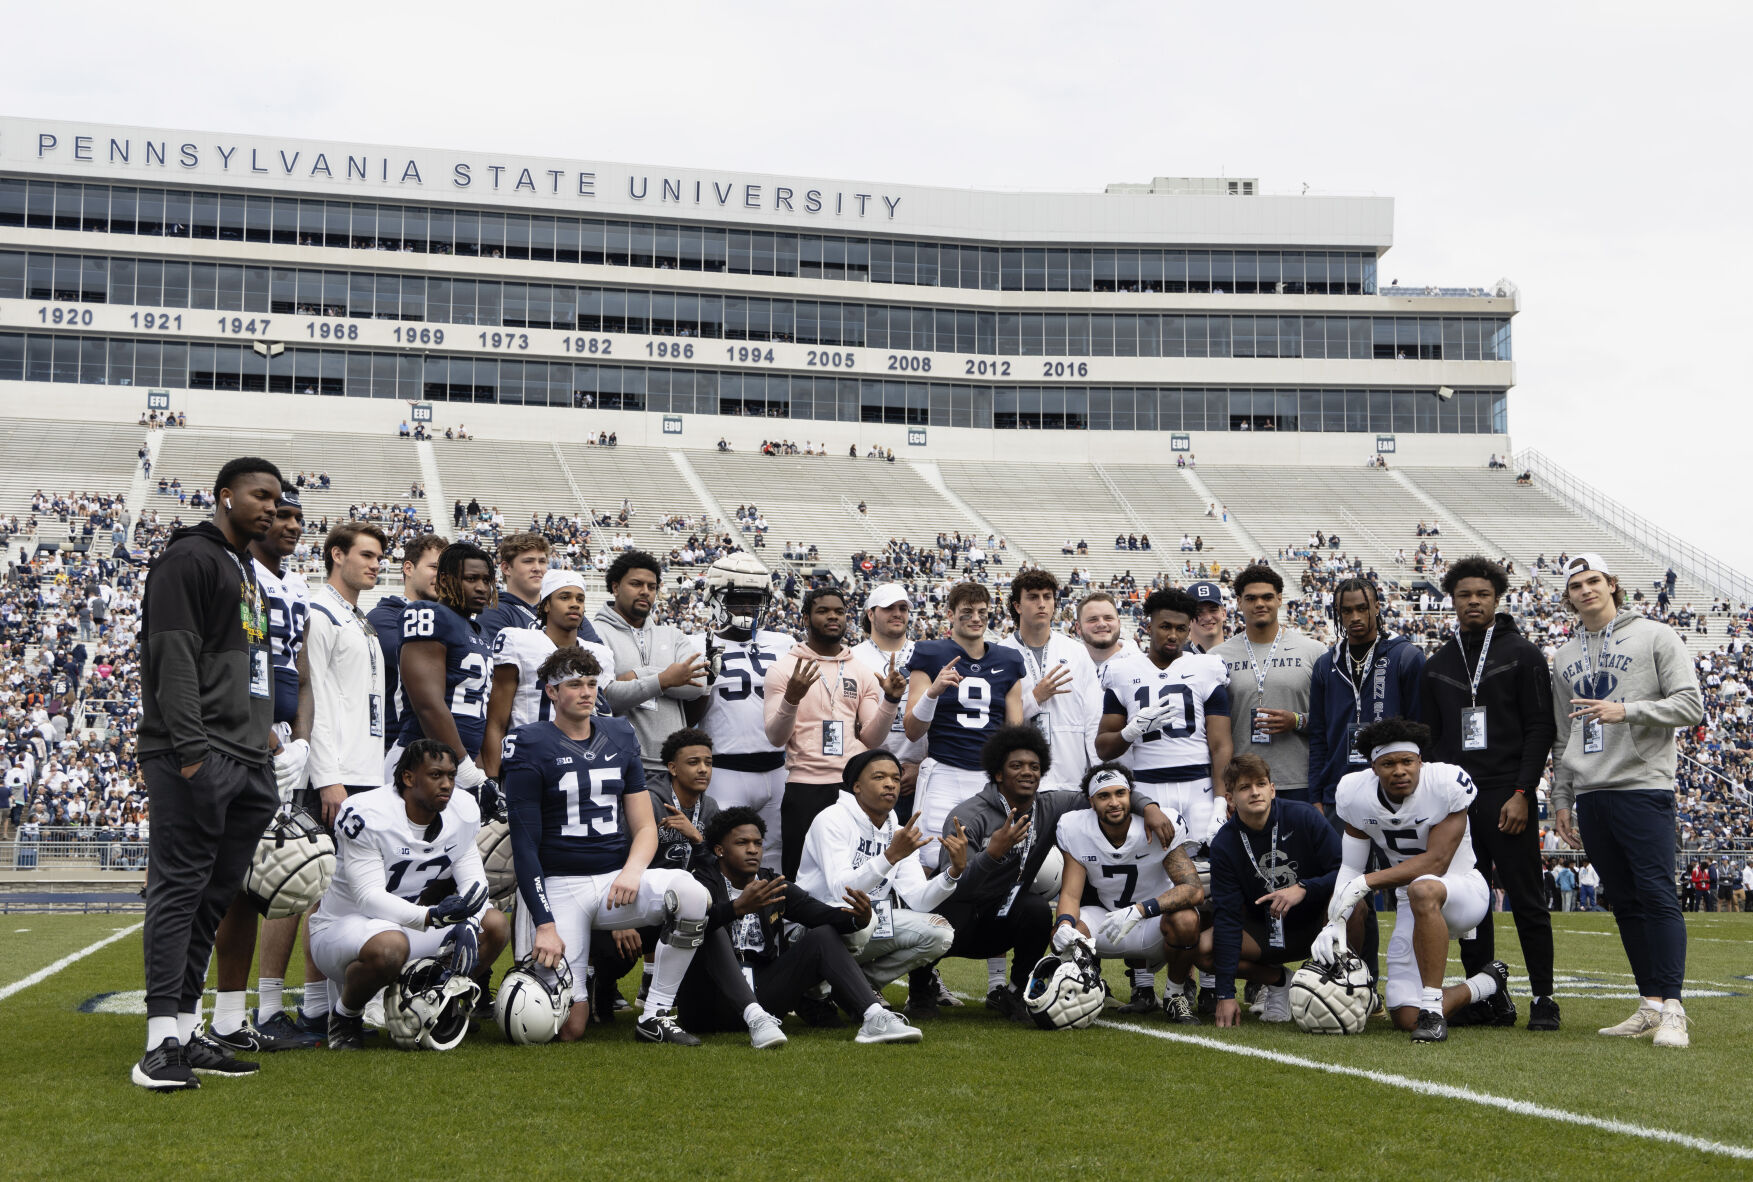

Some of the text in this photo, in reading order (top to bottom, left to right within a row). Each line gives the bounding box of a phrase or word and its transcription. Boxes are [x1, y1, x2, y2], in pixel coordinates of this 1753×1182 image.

[38, 133, 902, 219] PENNSYLVANIA STATE UNIVERSITY
[38, 306, 1088, 378] 1920 1921 1947 1968 1969 1973 1982 1986 1994 2005 2008 2012 2016
[149, 395, 168, 408] EFU
[413, 408, 430, 420] EEU
[664, 420, 682, 432] EDU
[909, 432, 926, 444] ECU
[1172, 438, 1189, 449] EBU
[1378, 440, 1395, 451] EAU
[1199, 586, 1209, 596] S
[404, 608, 435, 637] 28
[719, 651, 777, 701] 55
[956, 676, 992, 729] 9
[1134, 683, 1197, 742] 10
[1456, 771, 1475, 795] 5
[558, 767, 622, 837] 15
[337, 806, 366, 840] 13
[1381, 828, 1428, 864] 5
[1101, 864, 1138, 908] 7
